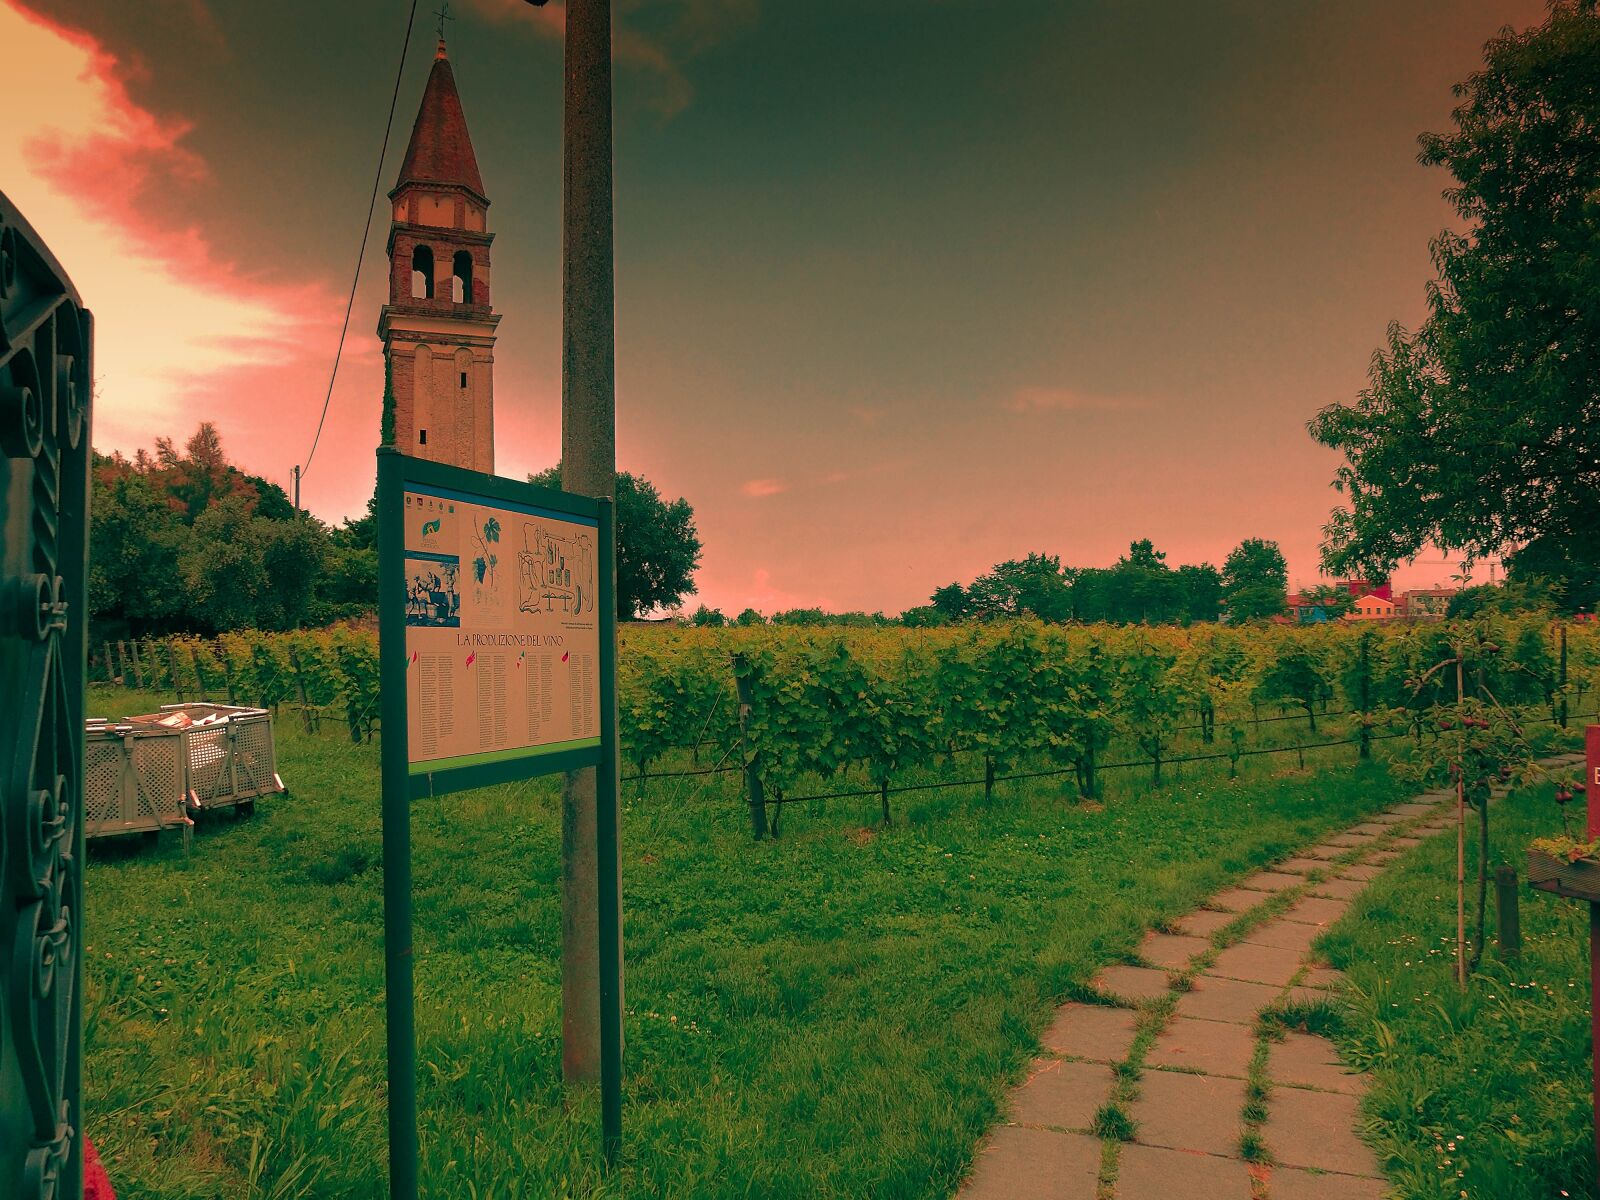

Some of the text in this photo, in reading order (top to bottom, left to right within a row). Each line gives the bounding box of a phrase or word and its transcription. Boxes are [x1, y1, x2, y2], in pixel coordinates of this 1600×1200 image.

[457, 633, 564, 647] LA PRODUZIONE DEL VINO
